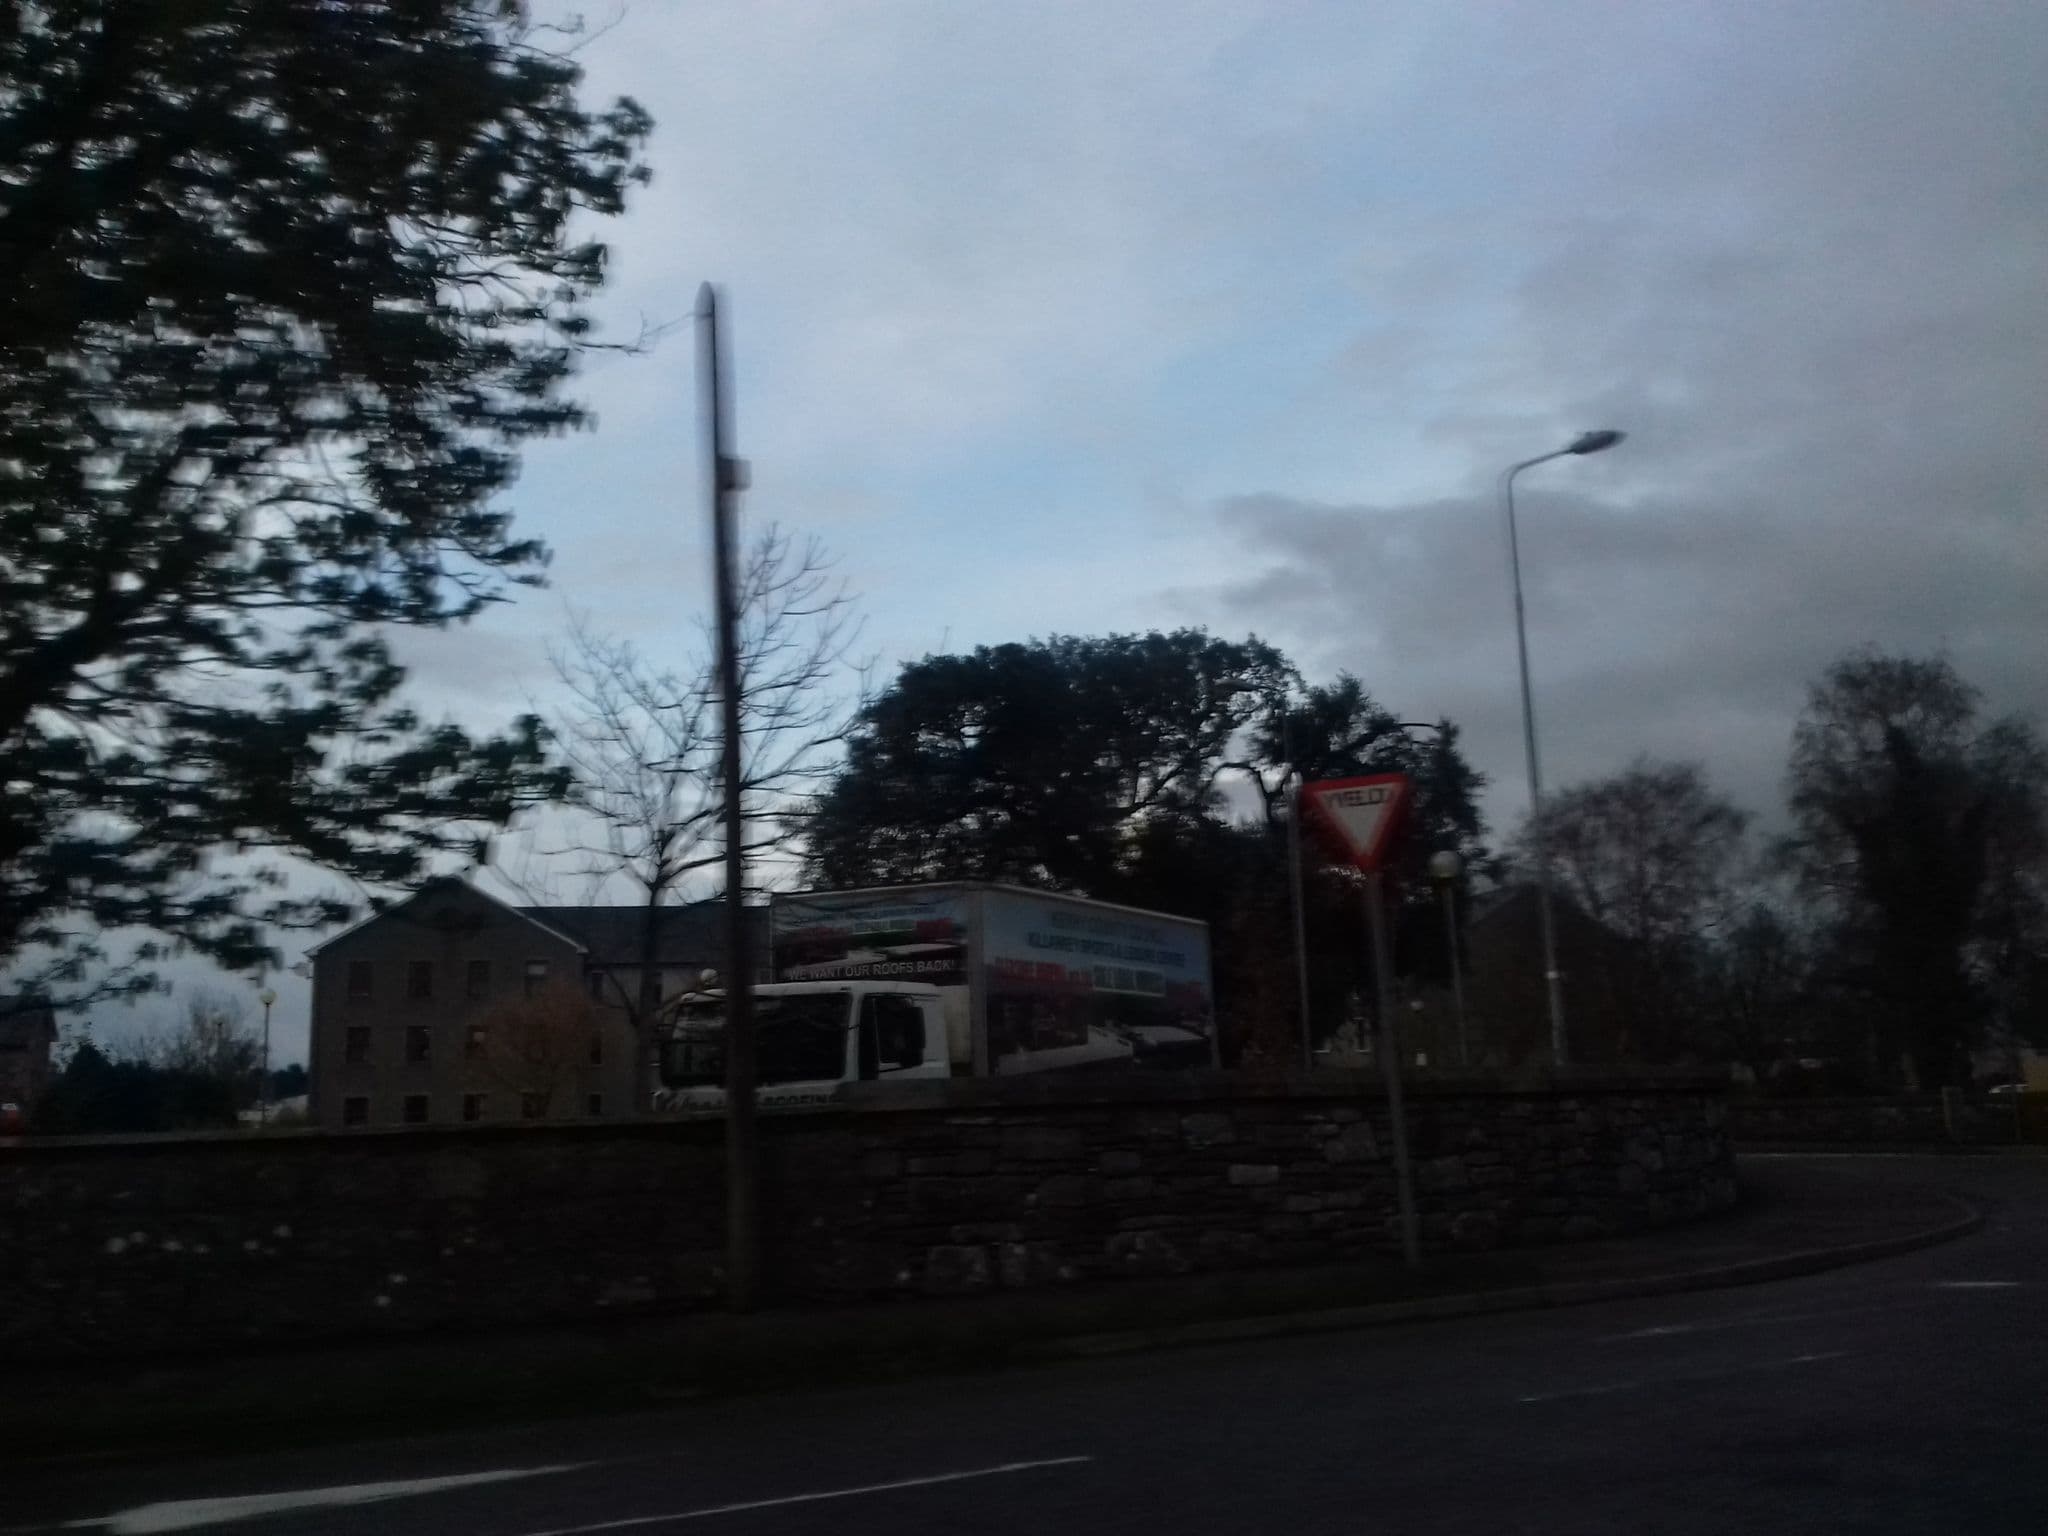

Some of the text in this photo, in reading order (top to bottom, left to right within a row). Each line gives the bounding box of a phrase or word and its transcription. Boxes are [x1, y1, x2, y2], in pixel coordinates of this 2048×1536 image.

[789, 968, 807, 981] WE
[811, 966, 843, 980] WANT
[845, 964, 871, 977] OUR
[873, 961, 913, 976] ROOFS
